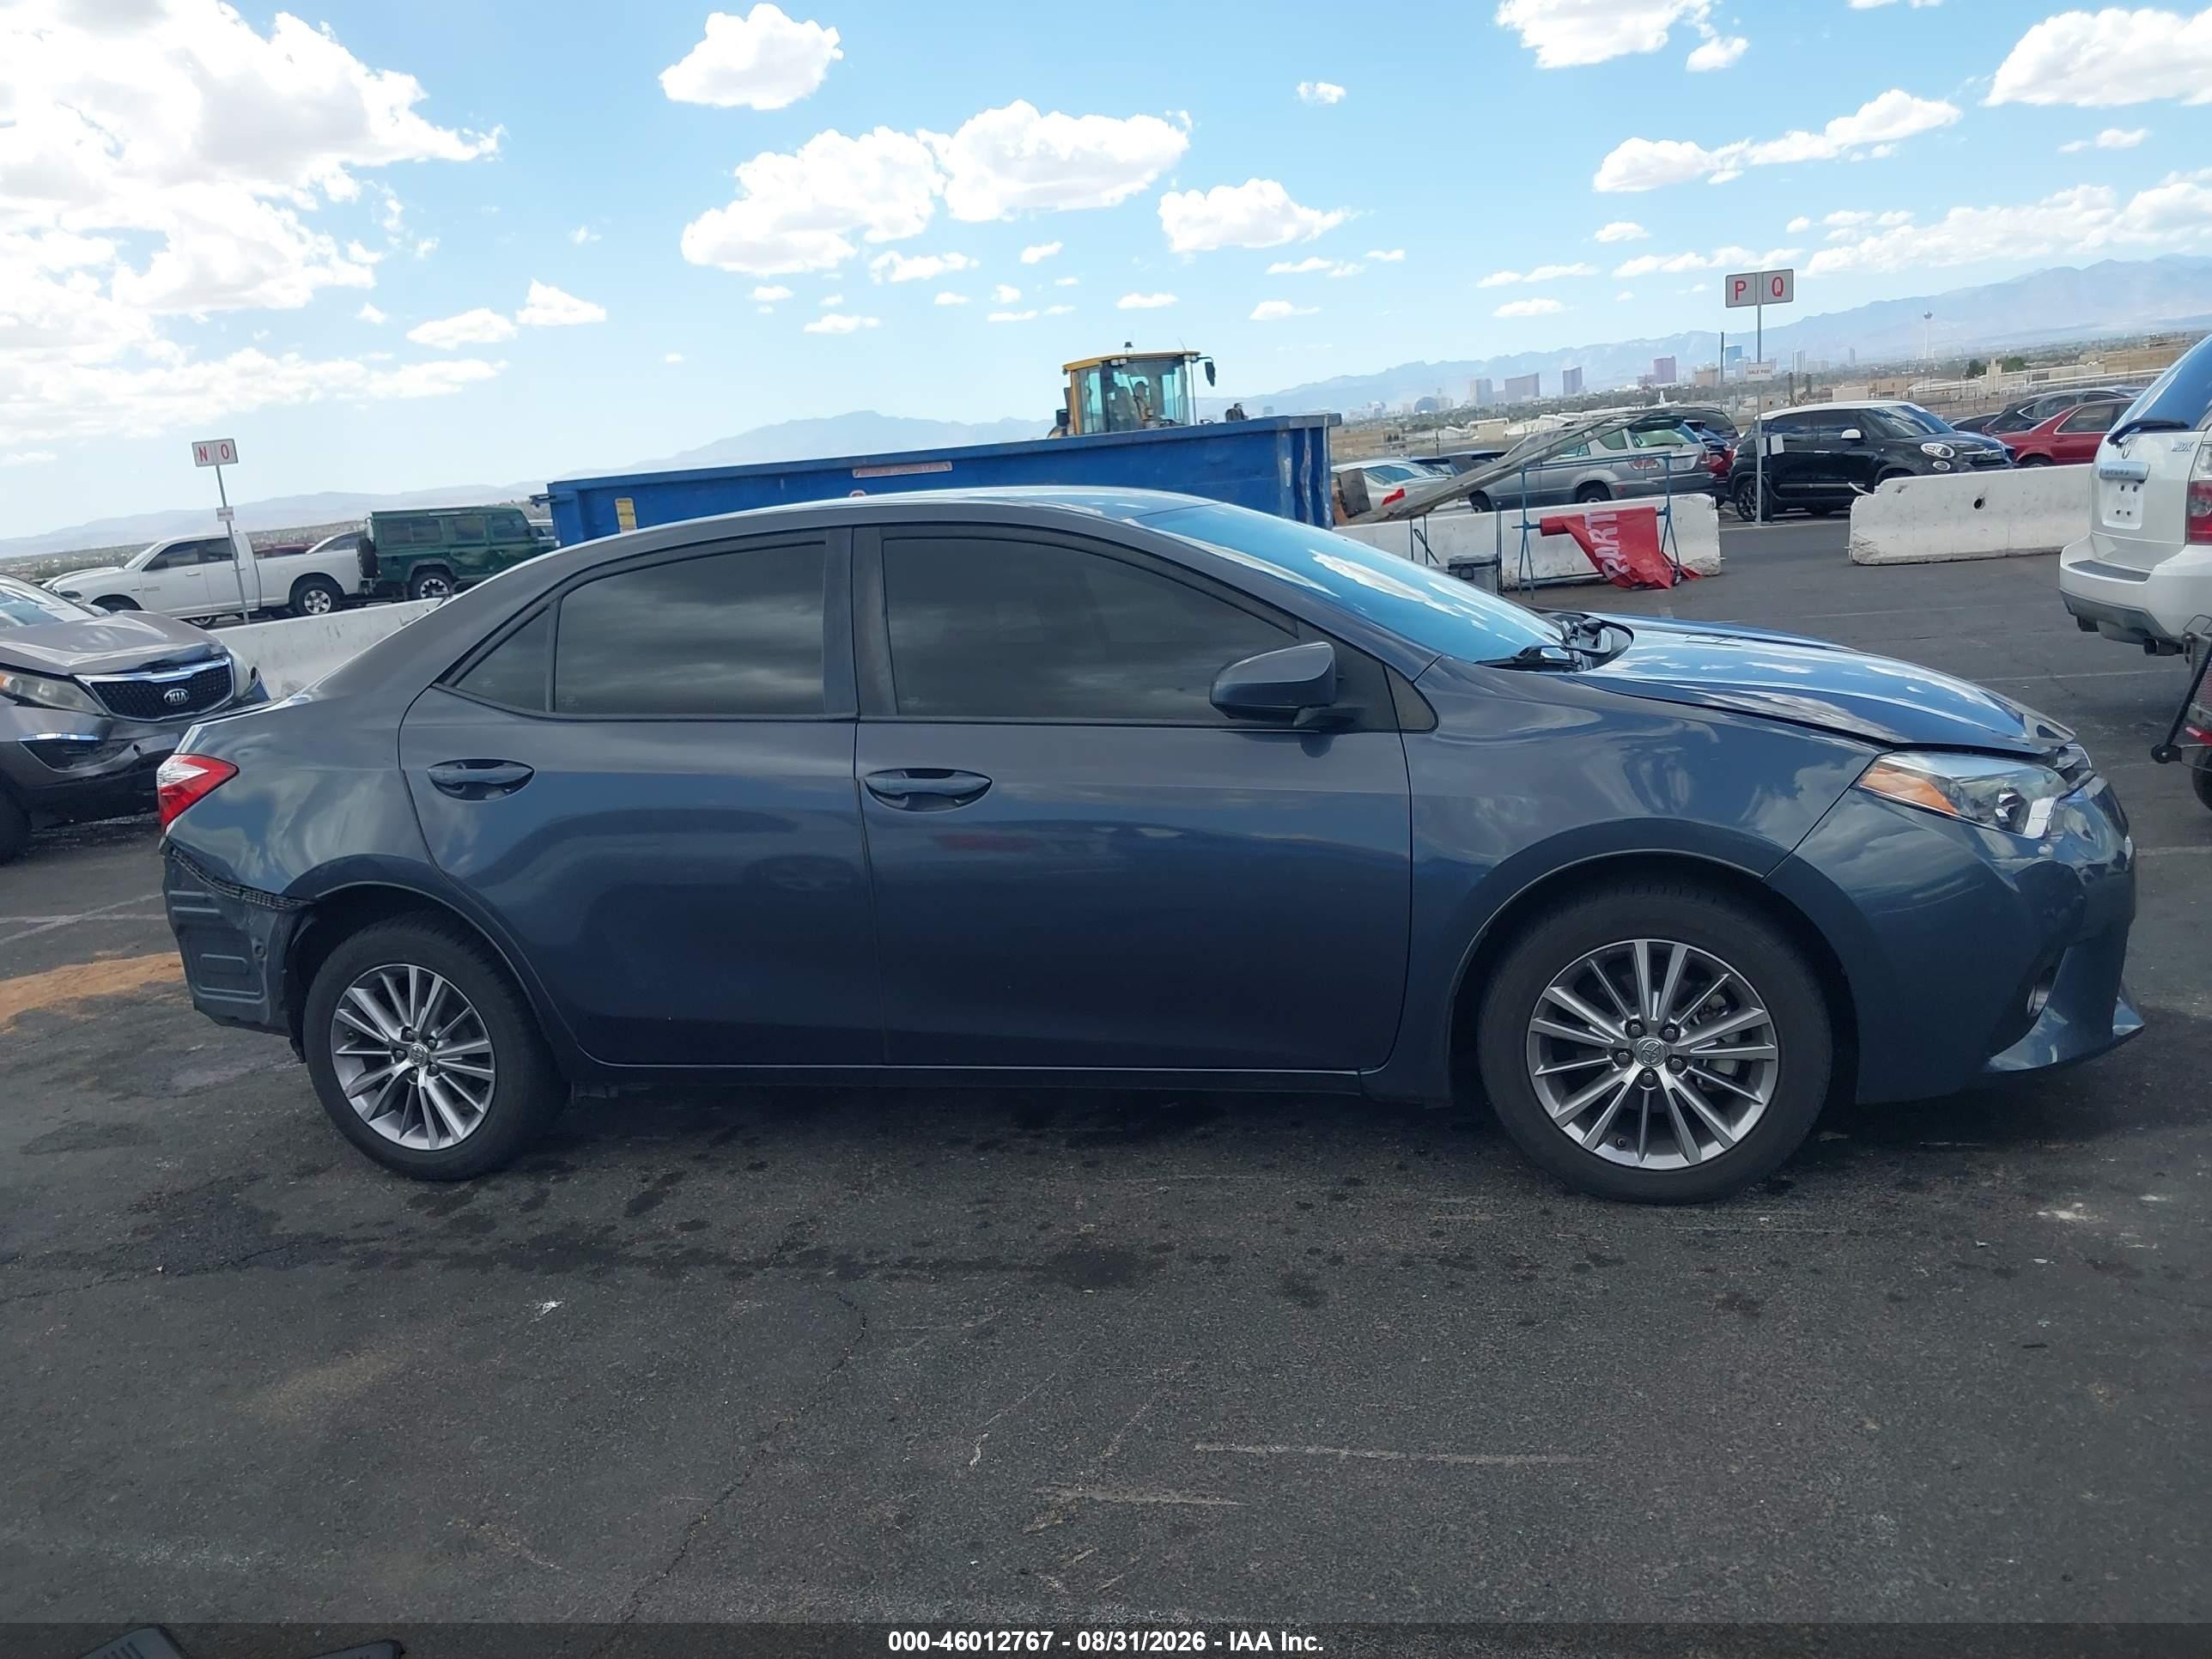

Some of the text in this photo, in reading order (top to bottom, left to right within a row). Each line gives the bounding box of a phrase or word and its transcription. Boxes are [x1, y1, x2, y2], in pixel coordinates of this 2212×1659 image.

[1735, 276, 1784, 301] P Q
[198, 443, 230, 461] N O
[169, 691, 186, 702] KIA
